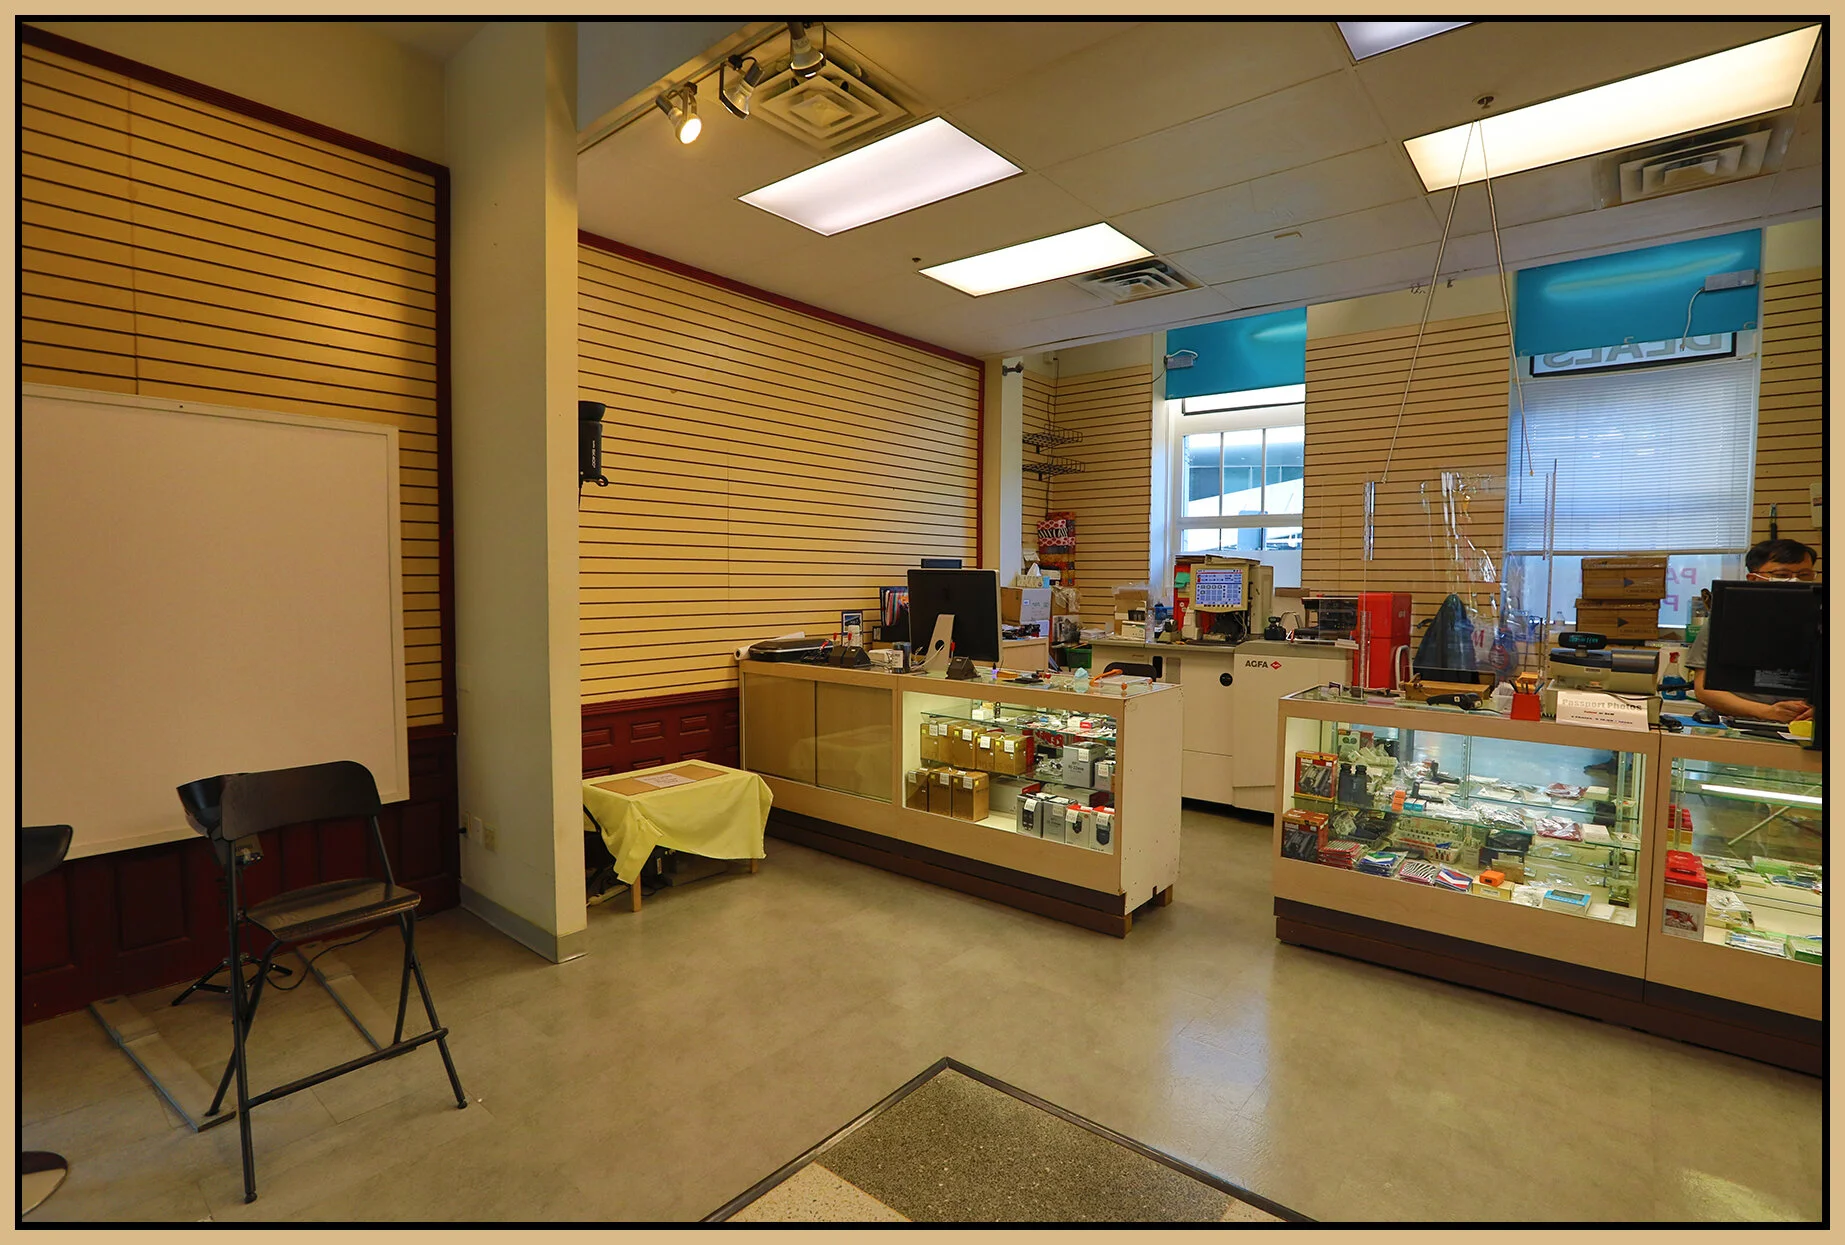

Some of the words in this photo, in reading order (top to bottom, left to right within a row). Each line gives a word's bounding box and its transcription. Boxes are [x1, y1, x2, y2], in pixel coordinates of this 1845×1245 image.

[1245, 660, 1269, 669] AGFA
[1562, 698, 1605, 709] Passport
[1607, 701, 1643, 712] Photos
